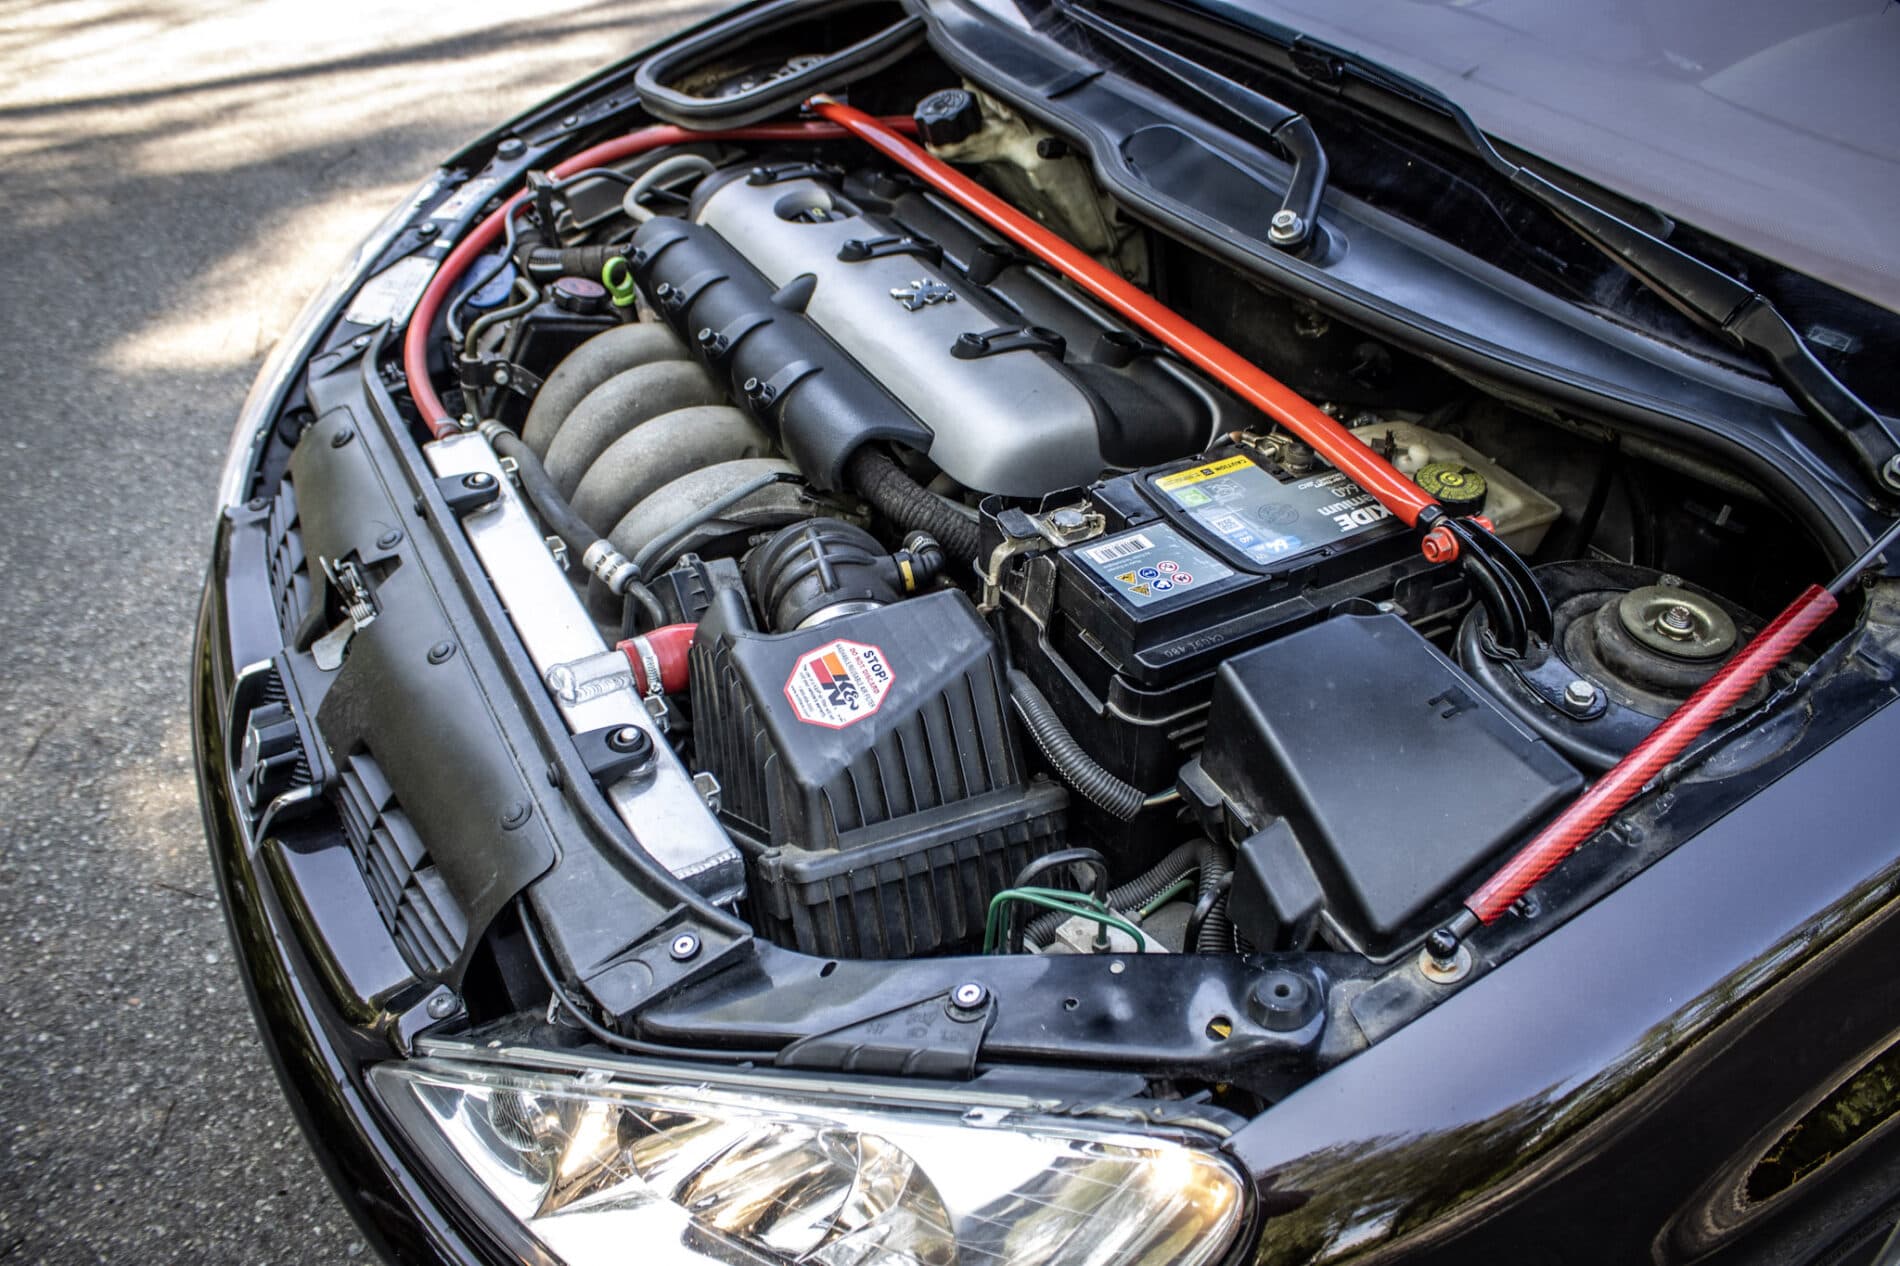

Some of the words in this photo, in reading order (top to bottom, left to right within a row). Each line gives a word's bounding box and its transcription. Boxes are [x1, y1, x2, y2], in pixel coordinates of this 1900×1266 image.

[1317, 493, 1374, 516] emium
[1333, 504, 1394, 533] XIDE
[863, 650, 889, 683] STOP!
[820, 674, 859, 711] K&N
